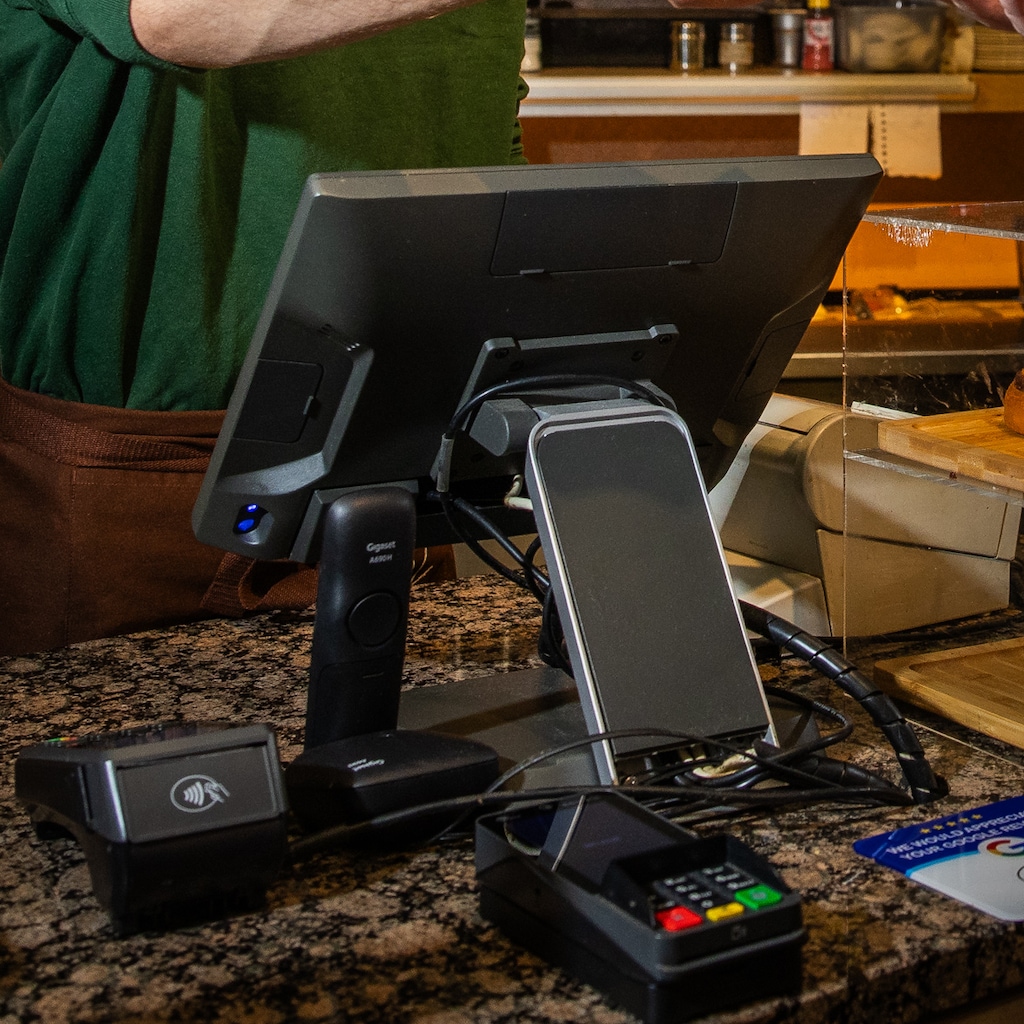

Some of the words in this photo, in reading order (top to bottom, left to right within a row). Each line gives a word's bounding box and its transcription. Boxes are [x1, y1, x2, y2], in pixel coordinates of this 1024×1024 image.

[366, 541, 396, 553] Gigaset
[886, 842, 913, 856] WE
[911, 829, 964, 849] WOULD
[899, 845, 945, 861] YOUR
[941, 827, 1003, 850] GOOGLE
